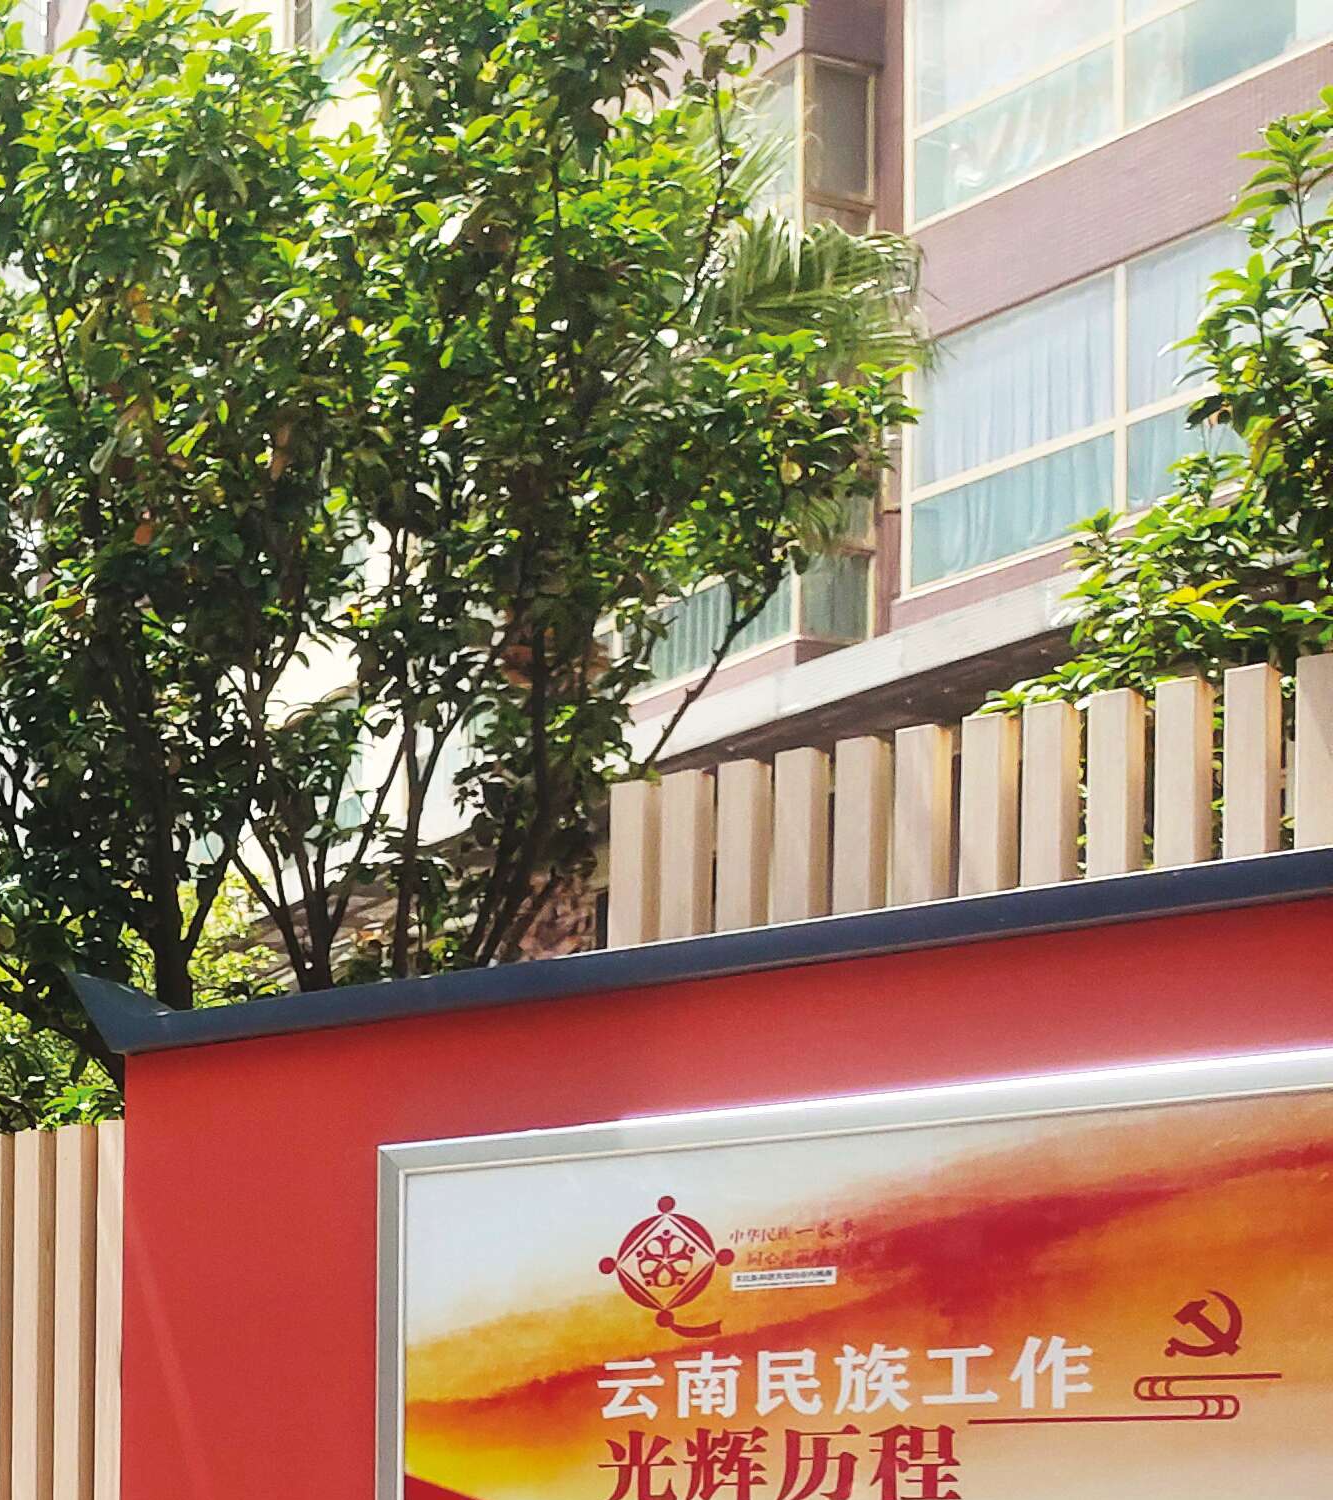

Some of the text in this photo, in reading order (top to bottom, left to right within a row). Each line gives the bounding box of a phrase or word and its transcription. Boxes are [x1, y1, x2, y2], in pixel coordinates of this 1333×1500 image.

[597, 1335, 1093, 1421] 云南民族工作
